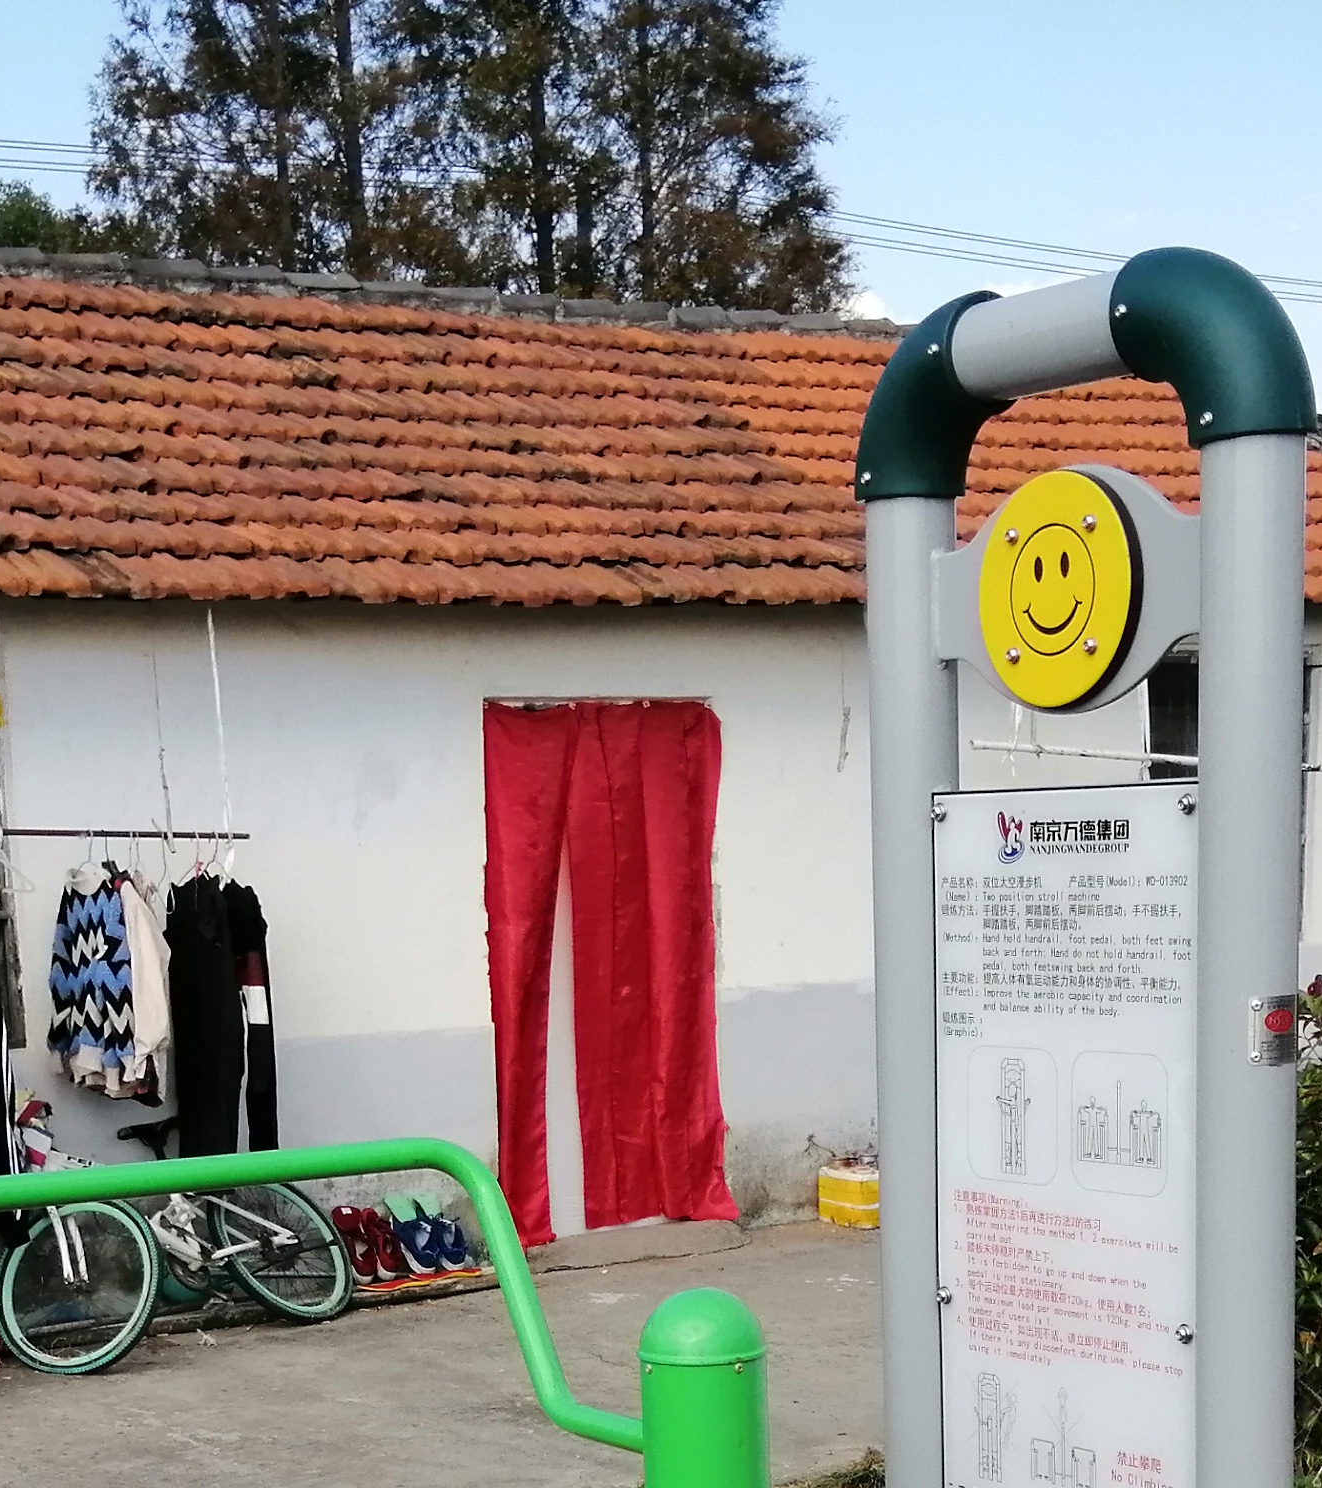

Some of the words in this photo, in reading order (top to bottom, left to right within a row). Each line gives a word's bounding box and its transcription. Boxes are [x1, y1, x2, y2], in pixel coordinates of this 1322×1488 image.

[1029, 819, 1129, 842] 南京万德集团
[1029, 842, 1130, 855] NANJINGWANDEGROUP
[1145, 875, 1188, 887] WD-013902
[982, 892, 995, 901] Two
[999, 892, 1034, 902] position
[1038, 892, 1064, 902] stroll
[1068, 892, 1100, 902] machine
[982, 933, 1000, 943] Hand
[1003, 934, 1021, 944] hold
[1069, 934, 1087, 944] foot
[1122, 934, 1141, 945] both
[1145, 934, 1163, 946] feet
[1168, 936, 1192, 948] swing
[982, 946, 999, 957] back
[1003, 948, 1017, 957] and
[1051, 948, 1069, 958] Hand
[1073, 948, 1083, 958] do
[1086, 950, 1099, 959] not
[1103, 949, 1123, 959] hold
[1173, 950, 1191, 960] foot
[1012, 961, 1030, 971] both
[1077, 962, 1095, 973] back
[1099, 963, 1113, 973] and
[983, 987, 1013, 999] Improve
[1017, 989, 1030, 999] the
[1033, 990, 1065, 1000] aerobic
[1068, 991, 1105, 1004] capacity
[1108, 992, 1123, 1002] and
[1126, 993, 1183, 1004] coordination
[983, 1002, 996, 1012] and
[999, 1002, 1030, 1012] balance
[1033, 1003, 1065, 1016] ability
[1068, 1005, 1078, 1014] of
[1081, 1006, 1095, 1016] the
[1099, 1006, 1120, 1018] body.
[966, 1217, 987, 1229] After
[991, 1221, 1029, 1236] mastering
[1033, 1226, 1046, 1236] the
[1049, 1230, 1076, 1240] method
[1092, 1232, 1097, 1243] 2
[1101, 1236, 1142, 1249] exercises
[1146, 1240, 1165, 1252] will
[1169, 1243, 1179, 1254] be
[966, 1232, 996, 1242] carried
[967, 1255, 975, 1265] It
[981, 1257, 988, 1266] is
[992, 1258, 1030, 1272] forbidden
[1033, 1264, 1042, 1274] to
[1046, 1267, 1055, 1278] go
[1058, 1270, 1067, 1280] up
[1071, 1271, 1085, 1281] and
[1088, 1272, 1107, 1284] down
[1110, 1276, 1129, 1287] when
[1133, 1279, 1147, 1290] the
[967, 1268, 988, 1280] pedal
[993, 1271, 1001, 1281] is
[1003, 1274, 1017, 1284] not
[968, 1292, 981, 1302] The
[983, 1296, 1014, 1307] maximum
[1018, 1301, 1034, 1312] load
[1037, 1304, 1050, 1314] per
[1053, 1308, 1089, 1320] movement
[1094, 1314, 1103, 1323] is
[1137, 1321, 1152, 1331] and
[1155, 1322, 1170, 1334] the
[968, 1306, 993, 1317] number
[997, 1309, 1006, 1319] of
[1009, 1313, 1031, 1324] users
[1034, 1316, 1043, 1326] is
[968, 1343, 990, 1356] using
[994, 1346, 1002, 1356] it
[969, 1329, 977, 1340] If
[981, 1332, 1002, 1343] there
[1006, 1336, 1014, 1346] is
[1017, 1339, 1031, 1350] any
[1033, 1341, 1077, 1357] discomfort
[1080, 1349, 1107, 1364] during
[1132, 1359, 1161, 1372] please
[1165, 1364, 1184, 1378] stop
[1117, 1450, 1162, 1475] 禁止攀爬
[1111, 1468, 1123, 1483] No
